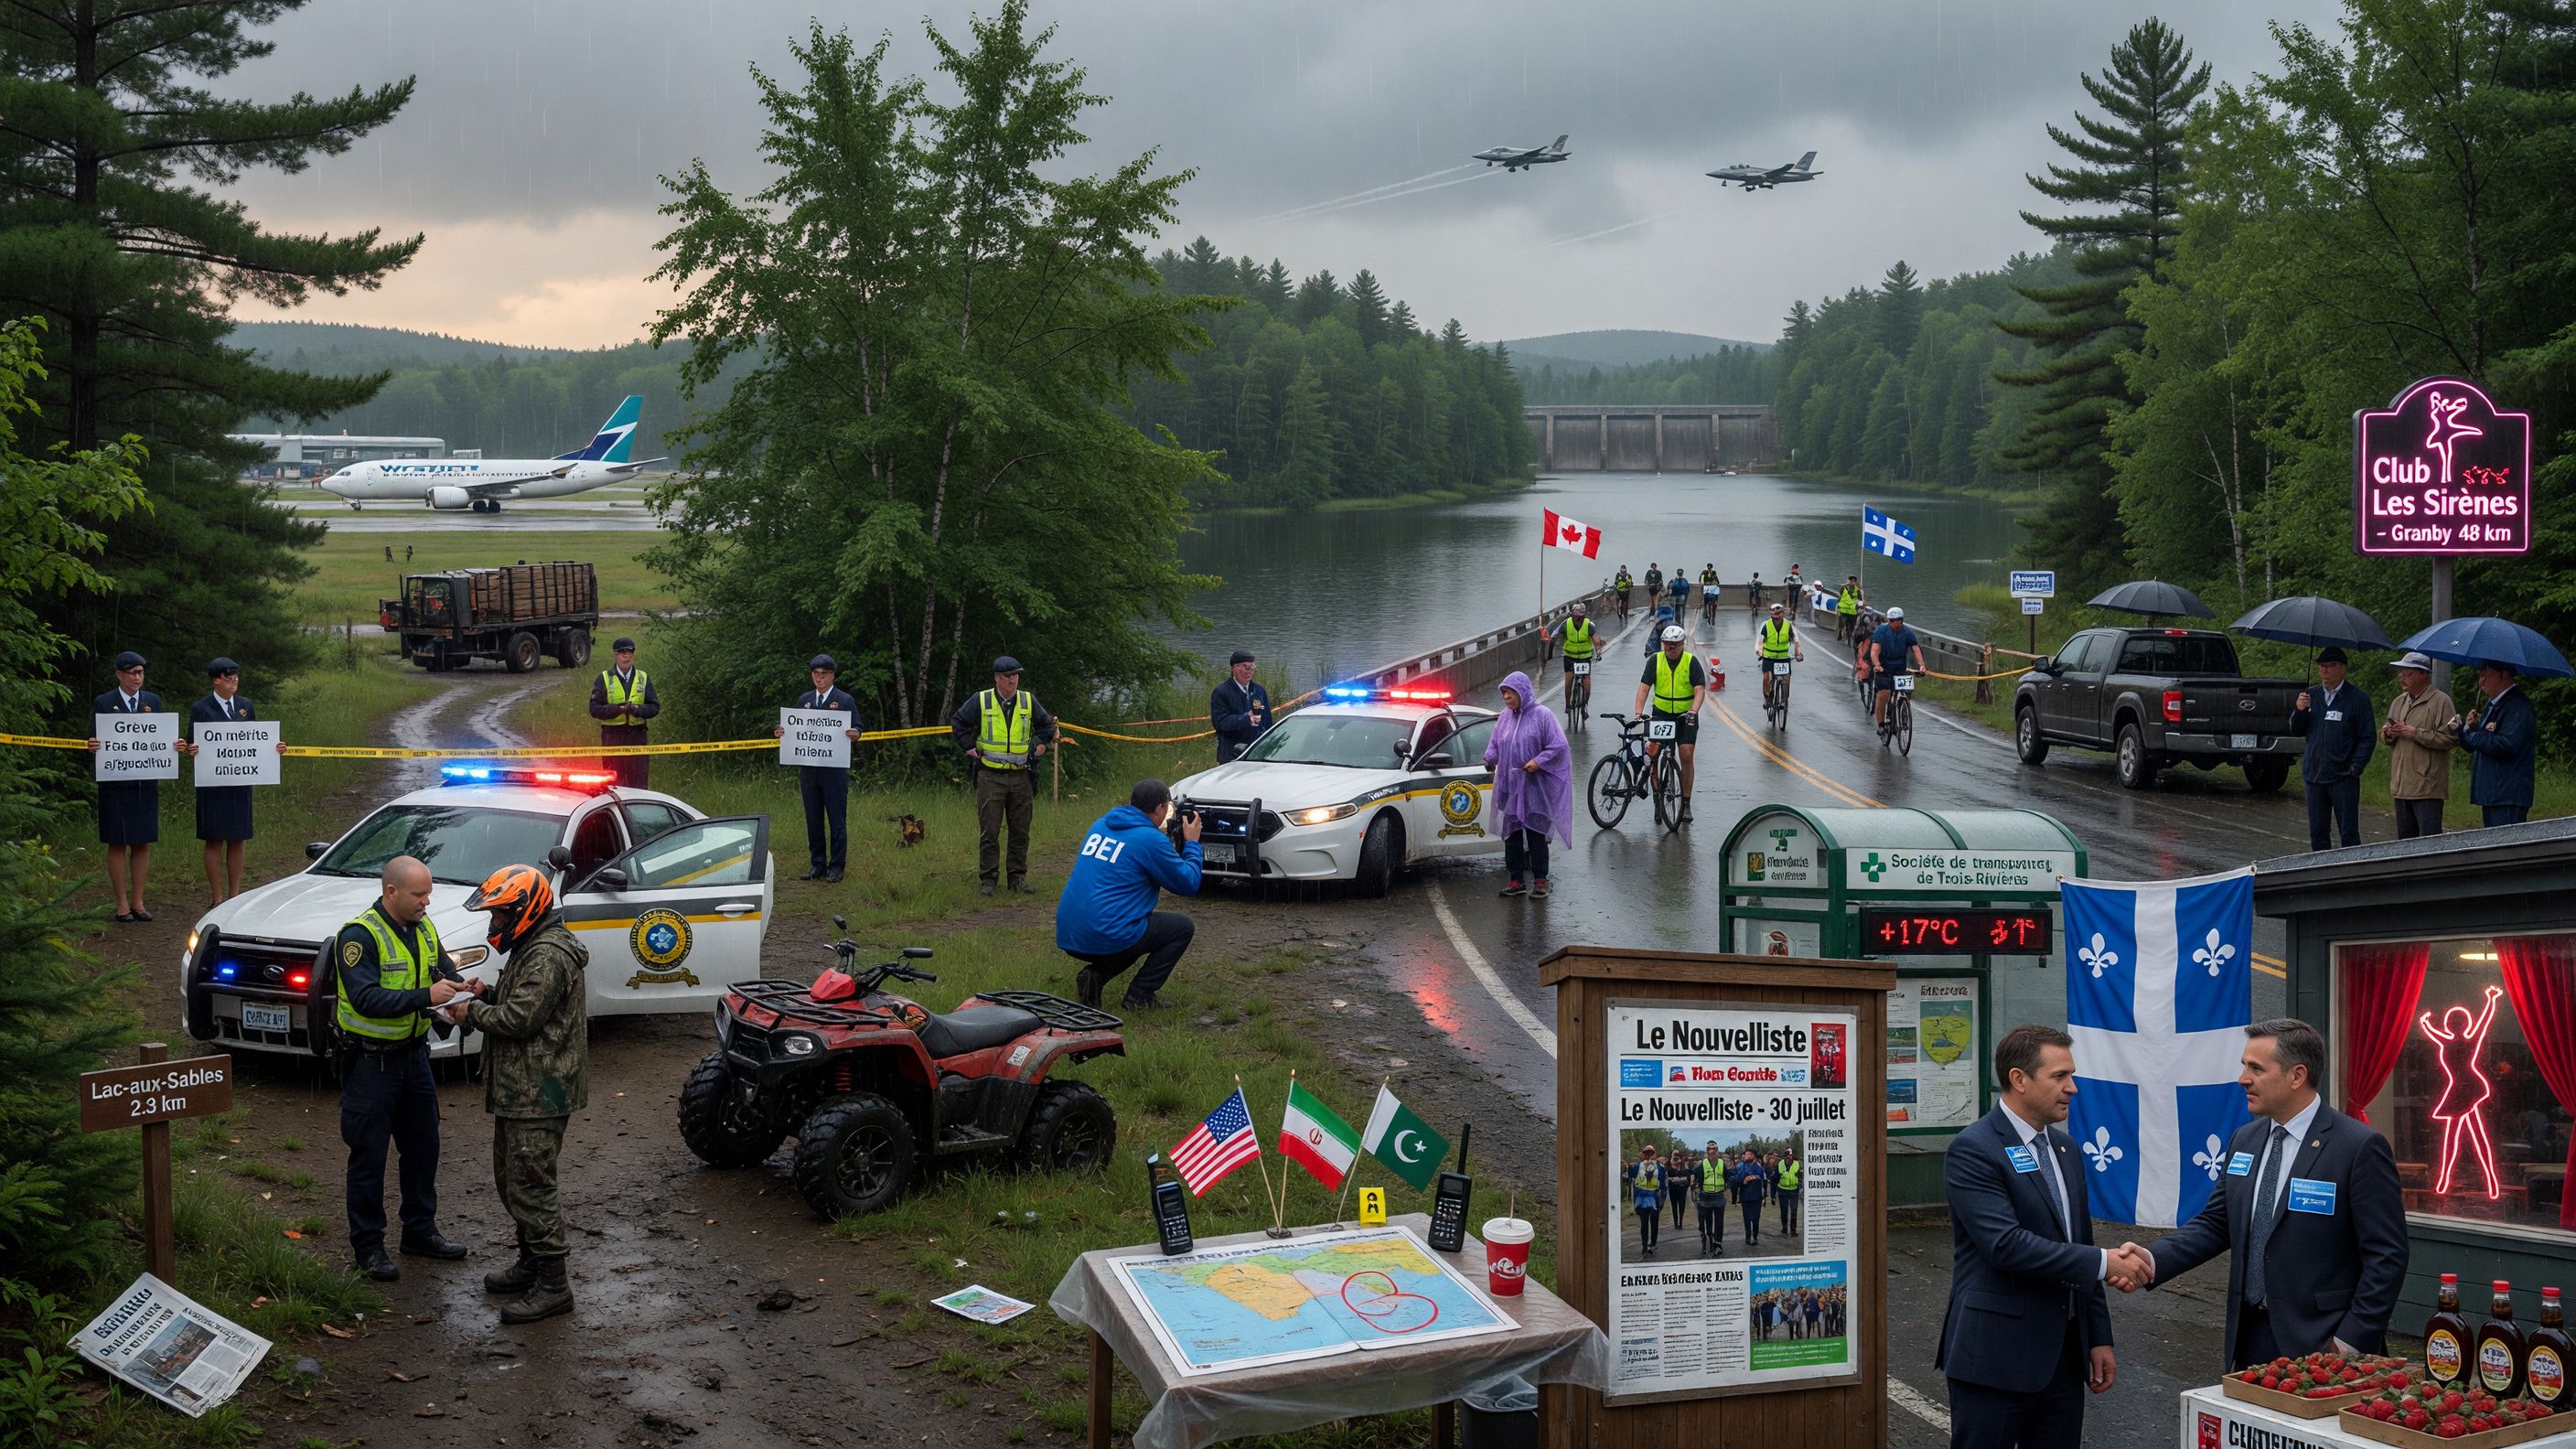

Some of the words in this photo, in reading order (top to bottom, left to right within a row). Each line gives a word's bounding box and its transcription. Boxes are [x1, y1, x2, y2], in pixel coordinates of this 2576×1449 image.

[2373, 456, 2431, 484] Club
[2373, 488, 2416, 516] Les
[2423, 488, 2518, 516] Sirènes
[2391, 523, 2452, 545] Granby
[2459, 523, 2480, 542] 48
[2485, 523, 2511, 542] km
[788, 714, 803, 725] On
[204, 730, 222, 741] On
[1081, 832, 1125, 864] BEI
[1891, 853, 1945, 868] Société
[1949, 855, 1967, 869] de
[1916, 872, 1934, 885] de
[1880, 918, 1959, 945] +17°C
[1637, 1019, 1666, 1049] Le
[1672, 1020, 1807, 1052] Nouvelliste
[91, 1068, 224, 1100] Lac-aux-Sables
[131, 1097, 156, 1117] 2.3
[162, 1095, 187, 1112] km
[1621, 1098, 1644, 1122] Le
[1649, 1098, 1753, 1122] Nouvelliste
[1770, 1098, 1792, 1121] 30
[1795, 1097, 1846, 1125] juillet
